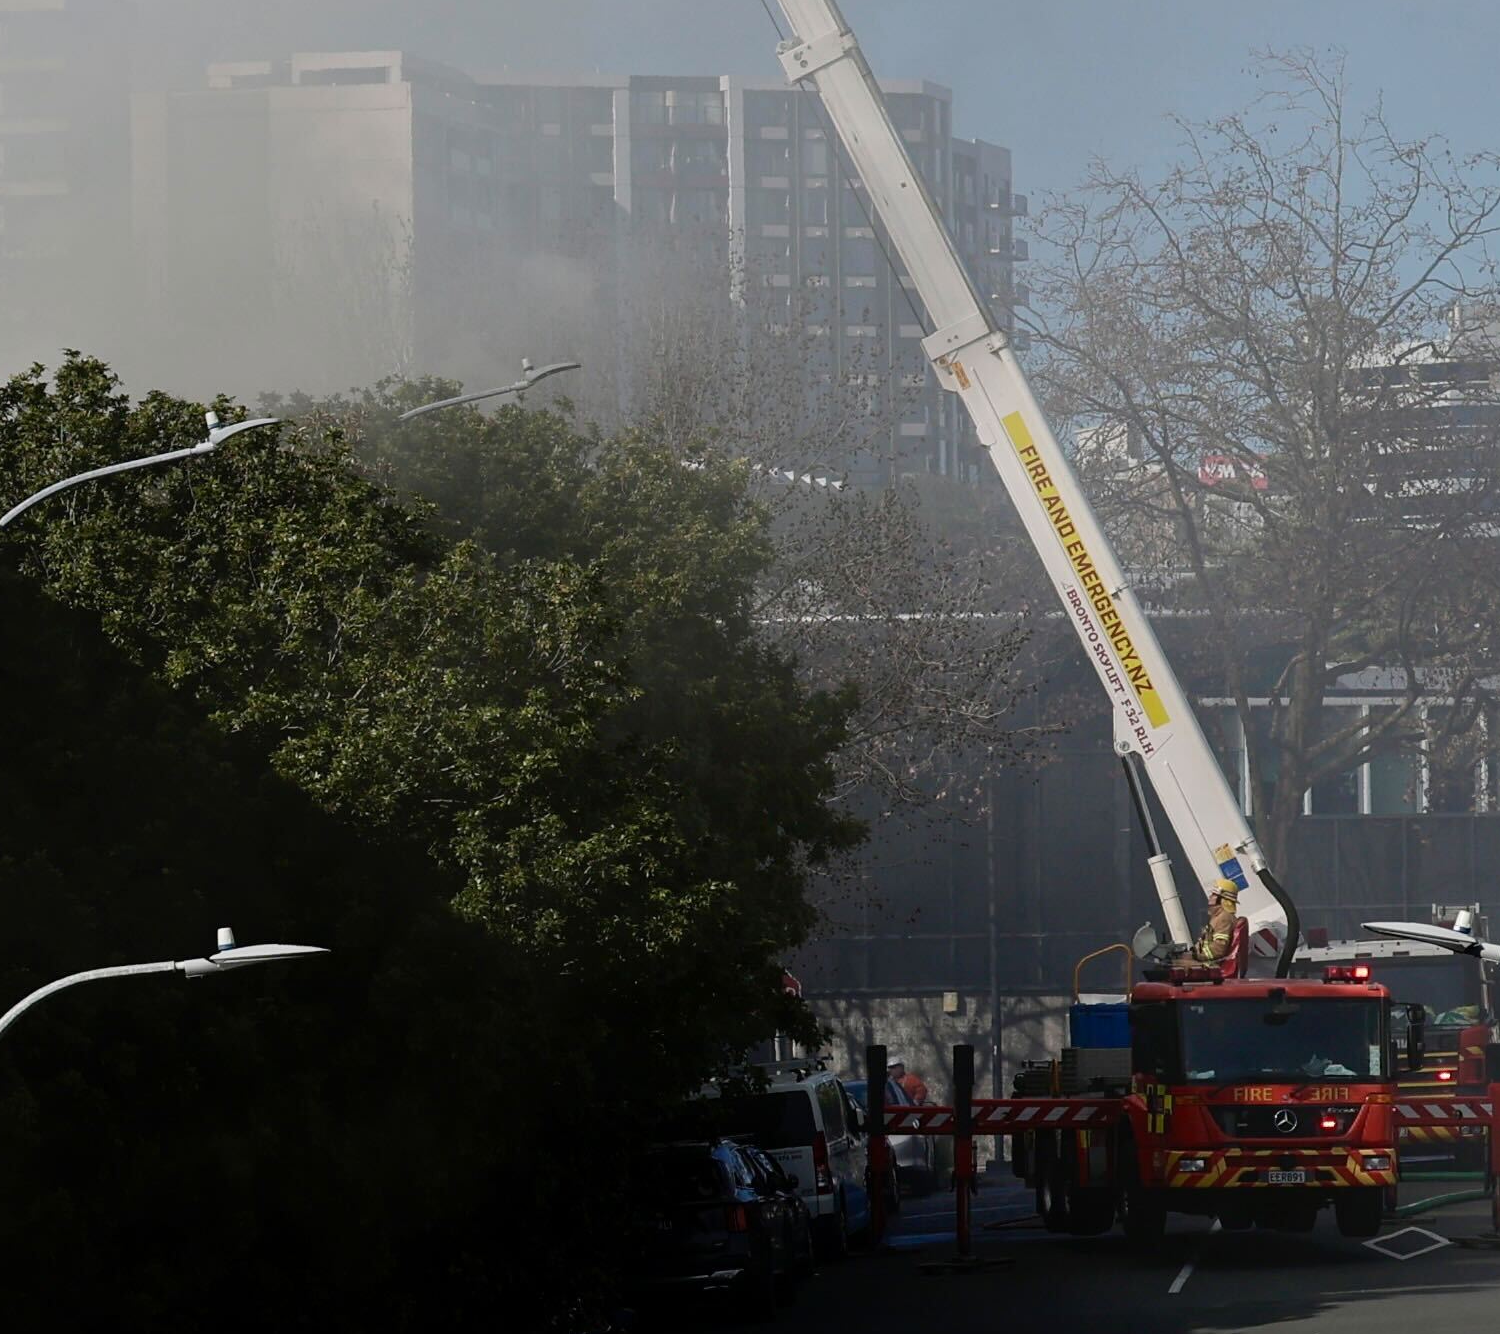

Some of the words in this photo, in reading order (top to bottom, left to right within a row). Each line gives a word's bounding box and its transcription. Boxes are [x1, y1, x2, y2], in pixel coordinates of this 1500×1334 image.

[1019, 444, 1054, 493] FIRE
[1043, 493, 1076, 537] AND
[1065, 540, 1154, 697] EMERGENCY.NZ
[1066, 588, 1099, 644] BRONTO
[1093, 642, 1125, 694] SKYLIFT
[1134, 721, 1154, 754] RLH
[1234, 1088, 1273, 1101] FIRE
